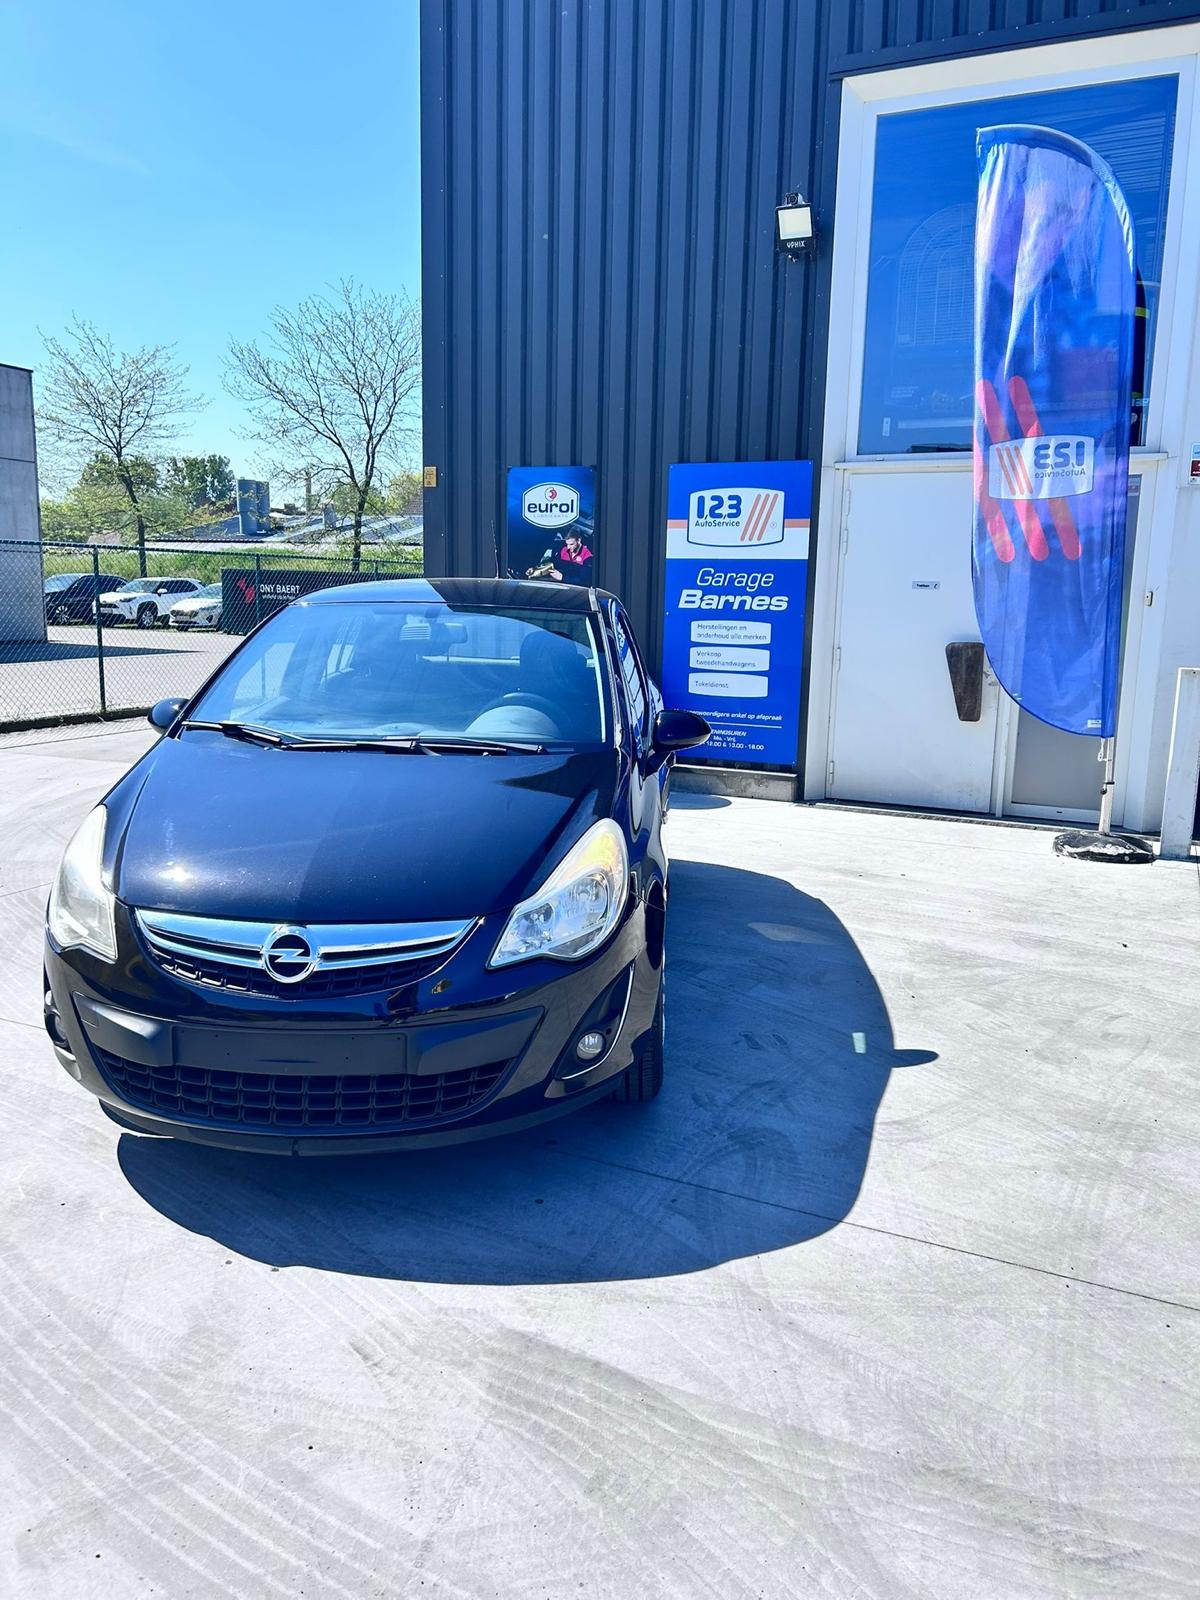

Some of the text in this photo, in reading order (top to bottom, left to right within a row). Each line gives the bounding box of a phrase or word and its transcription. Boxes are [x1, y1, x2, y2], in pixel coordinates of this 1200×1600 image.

[527, 499, 574, 513] eurol
[695, 519, 741, 527] AutoService
[696, 567, 775, 592] Garage
[259, 583, 300, 594] ONY BAERT
[678, 589, 789, 611] Barnes
[697, 623, 738, 631] Herstellingen
[710, 728, 747, 737] ENINGSUREN
